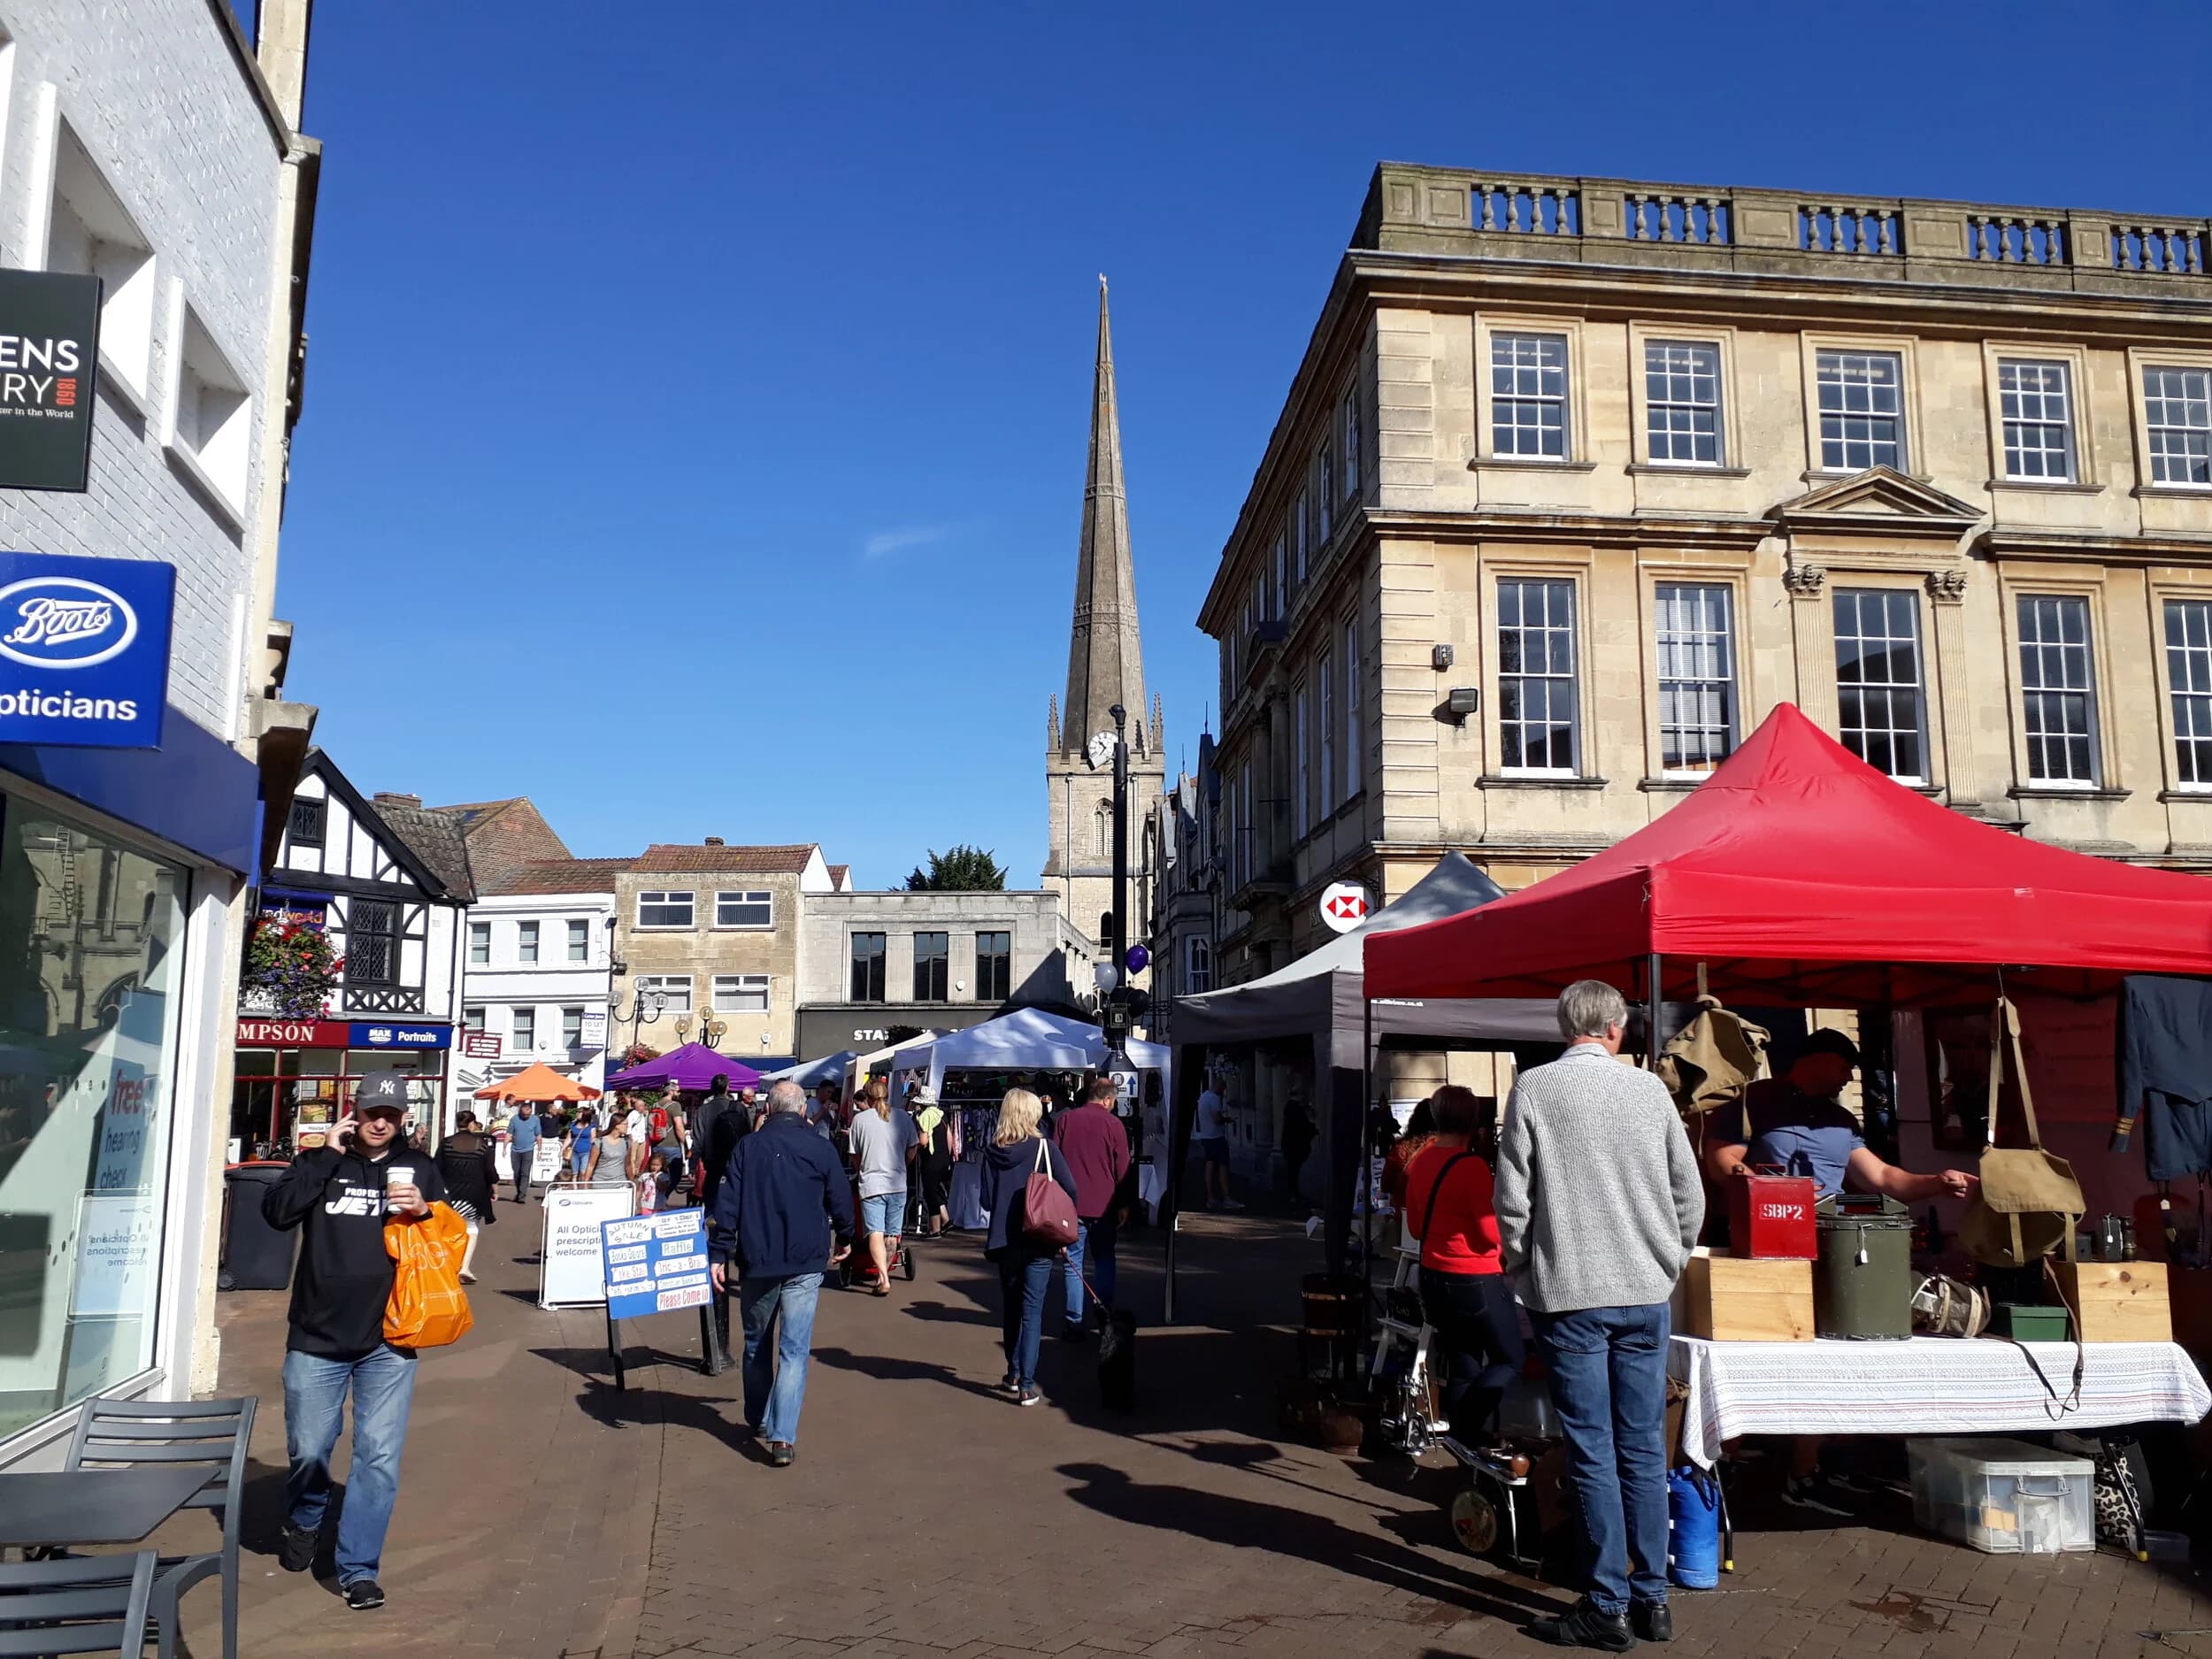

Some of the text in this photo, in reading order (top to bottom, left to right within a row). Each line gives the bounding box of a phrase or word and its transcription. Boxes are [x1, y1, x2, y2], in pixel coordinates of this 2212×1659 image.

[0, 334, 80, 372] ENS
[56, 377, 77, 406] 1860
[27, 408, 42, 417] the
[44, 409, 74, 419] World
[4, 597, 111, 646] Boots
[397, 1031, 437, 1042] Portraits
[111, 1069, 143, 1116] free
[104, 1127, 141, 1155] hearing
[99, 1165, 127, 1192] check
[1763, 1204, 1803, 1220] SBP2
[557, 1225, 569, 1234] All
[614, 1232, 643, 1243] SALE
[556, 1248, 597, 1256] welcome
[664, 1241, 693, 1254] Raffle
[659, 1293, 681, 1309] Please
[682, 1289, 701, 1305] Come
